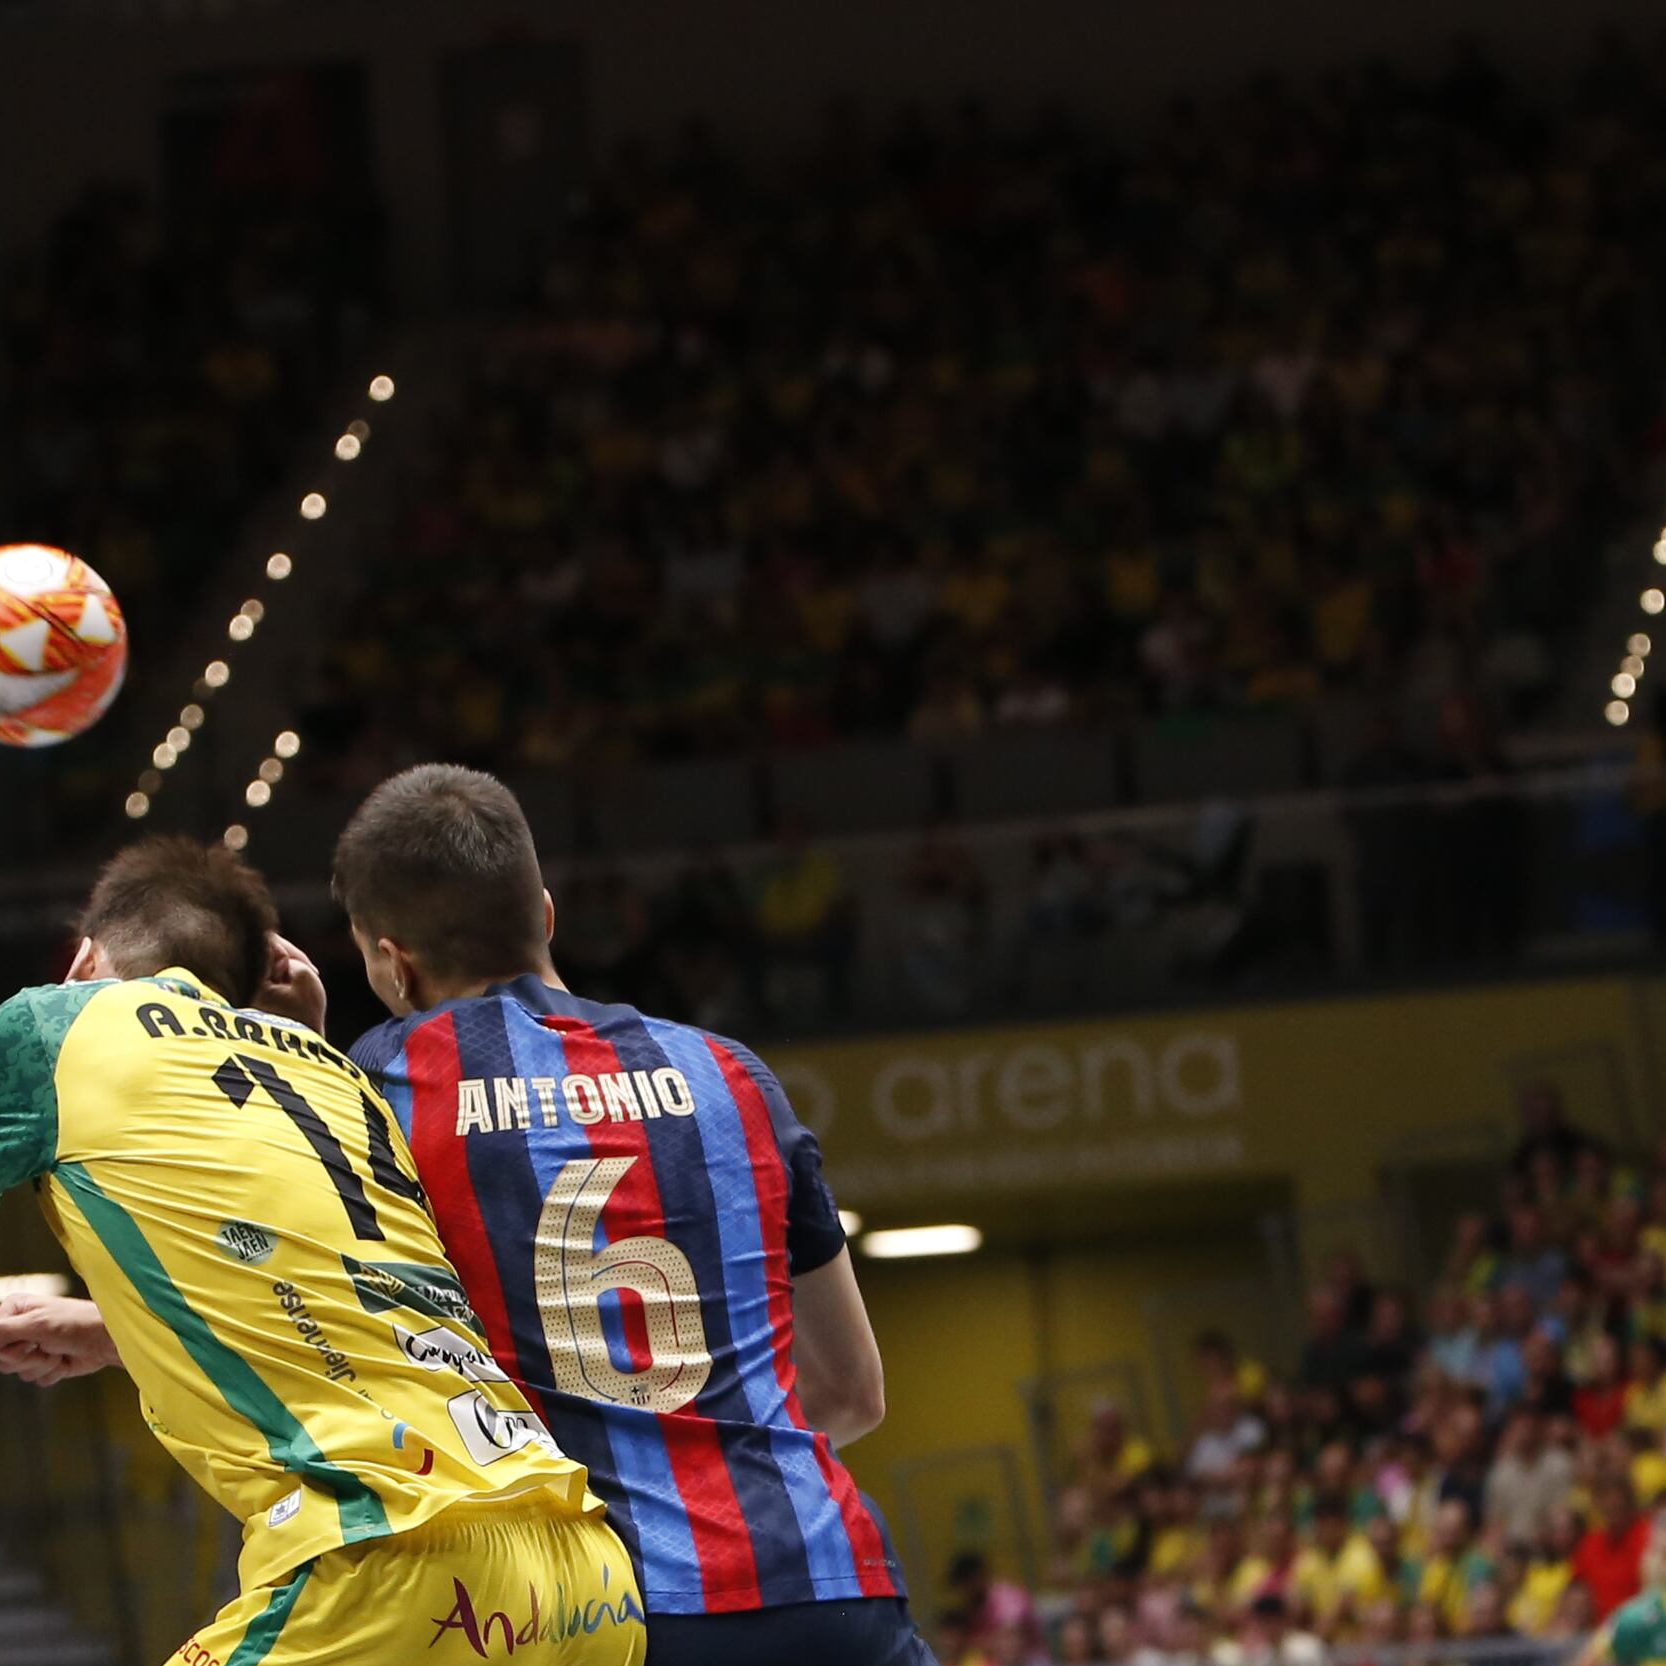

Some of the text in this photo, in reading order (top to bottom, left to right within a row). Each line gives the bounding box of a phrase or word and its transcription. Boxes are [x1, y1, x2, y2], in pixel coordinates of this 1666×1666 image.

[456, 1067, 697, 1137] ANTONIO
[870, 1033, 1241, 1139] arena
[534, 1156, 715, 1414] 6
